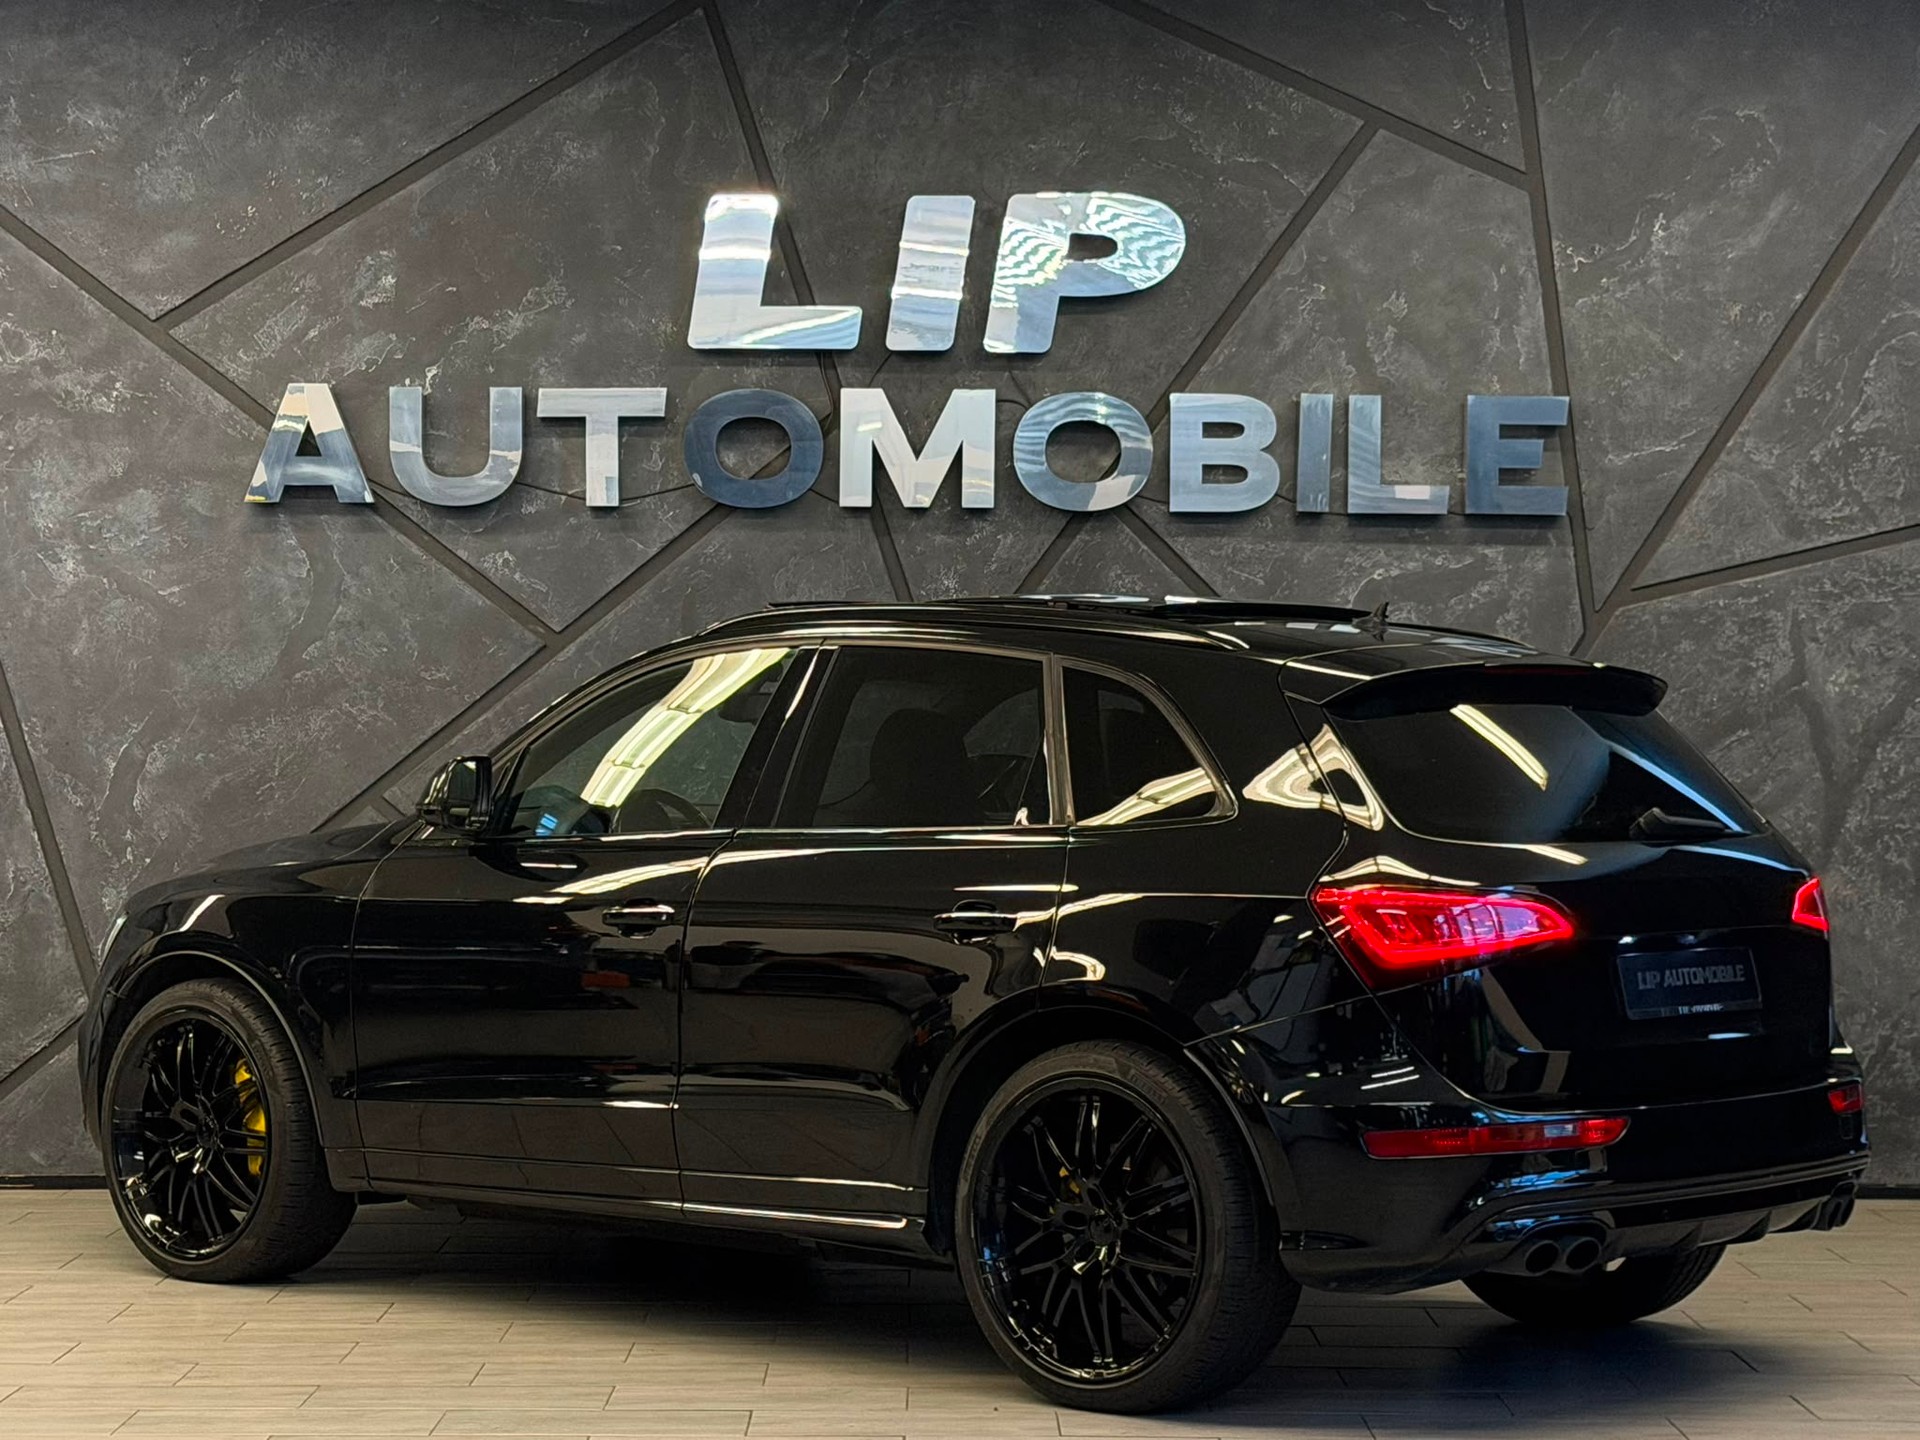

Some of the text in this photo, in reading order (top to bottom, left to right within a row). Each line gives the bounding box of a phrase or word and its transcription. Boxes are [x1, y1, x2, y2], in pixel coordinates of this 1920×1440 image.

[687, 191, 1187, 354] LIP
[245, 382, 1571, 516] AUTOMOBILE
[1637, 964, 1745, 990] LIP AUTOMOBILE
